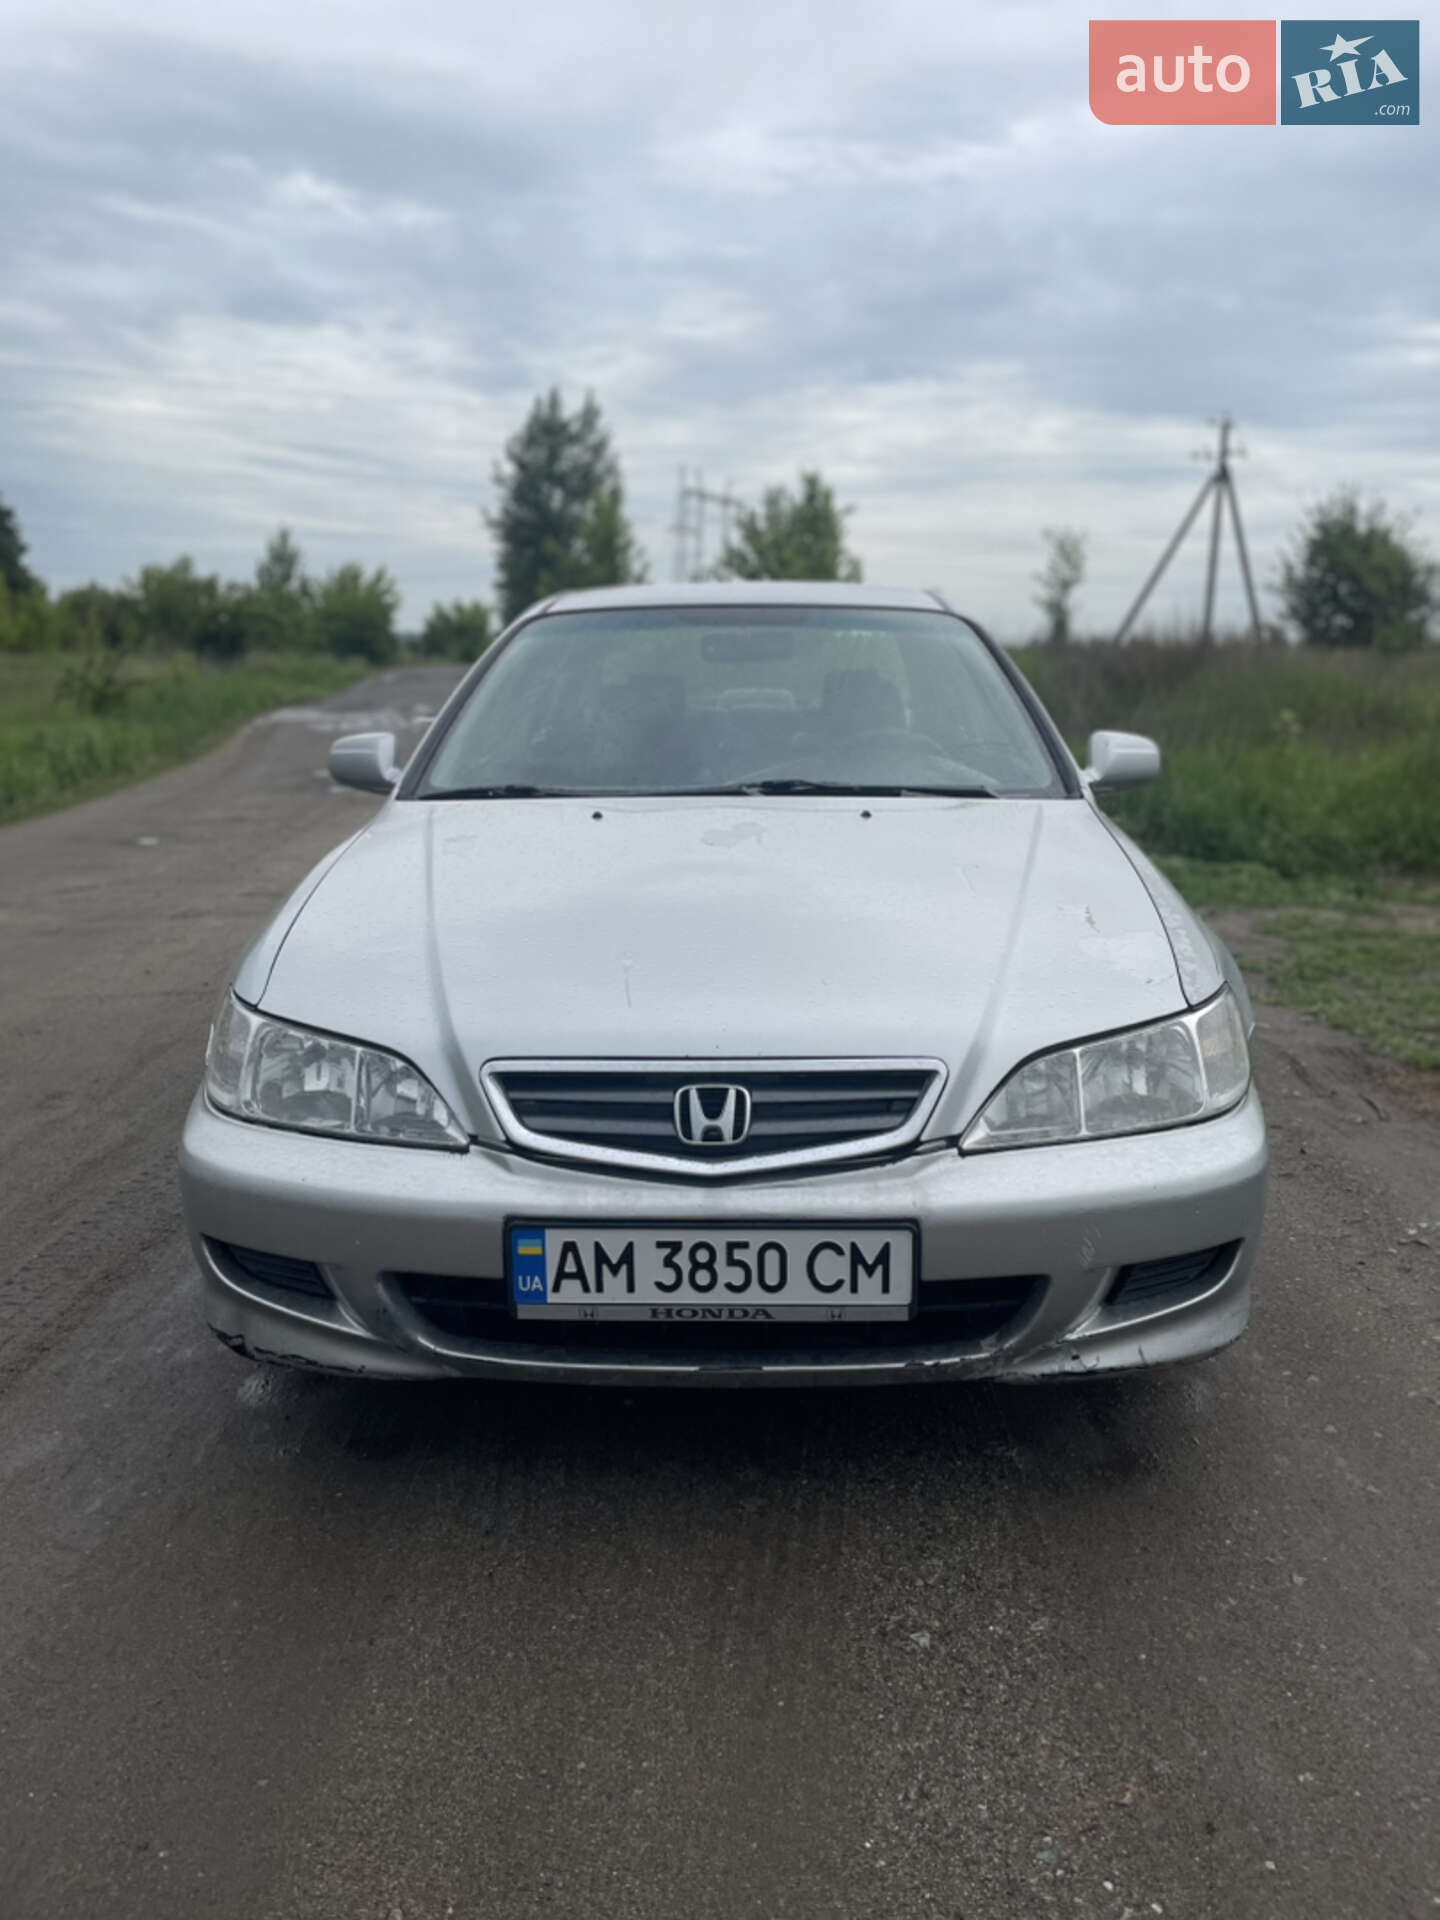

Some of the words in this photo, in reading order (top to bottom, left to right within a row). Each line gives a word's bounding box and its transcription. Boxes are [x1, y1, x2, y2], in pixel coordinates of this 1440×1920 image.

[551, 1241, 636, 1294] AM
[654, 1241, 788, 1294] 3850
[805, 1241, 891, 1294] CM
[518, 1275, 544, 1292] UA
[649, 1307, 775, 1320] HONDA
